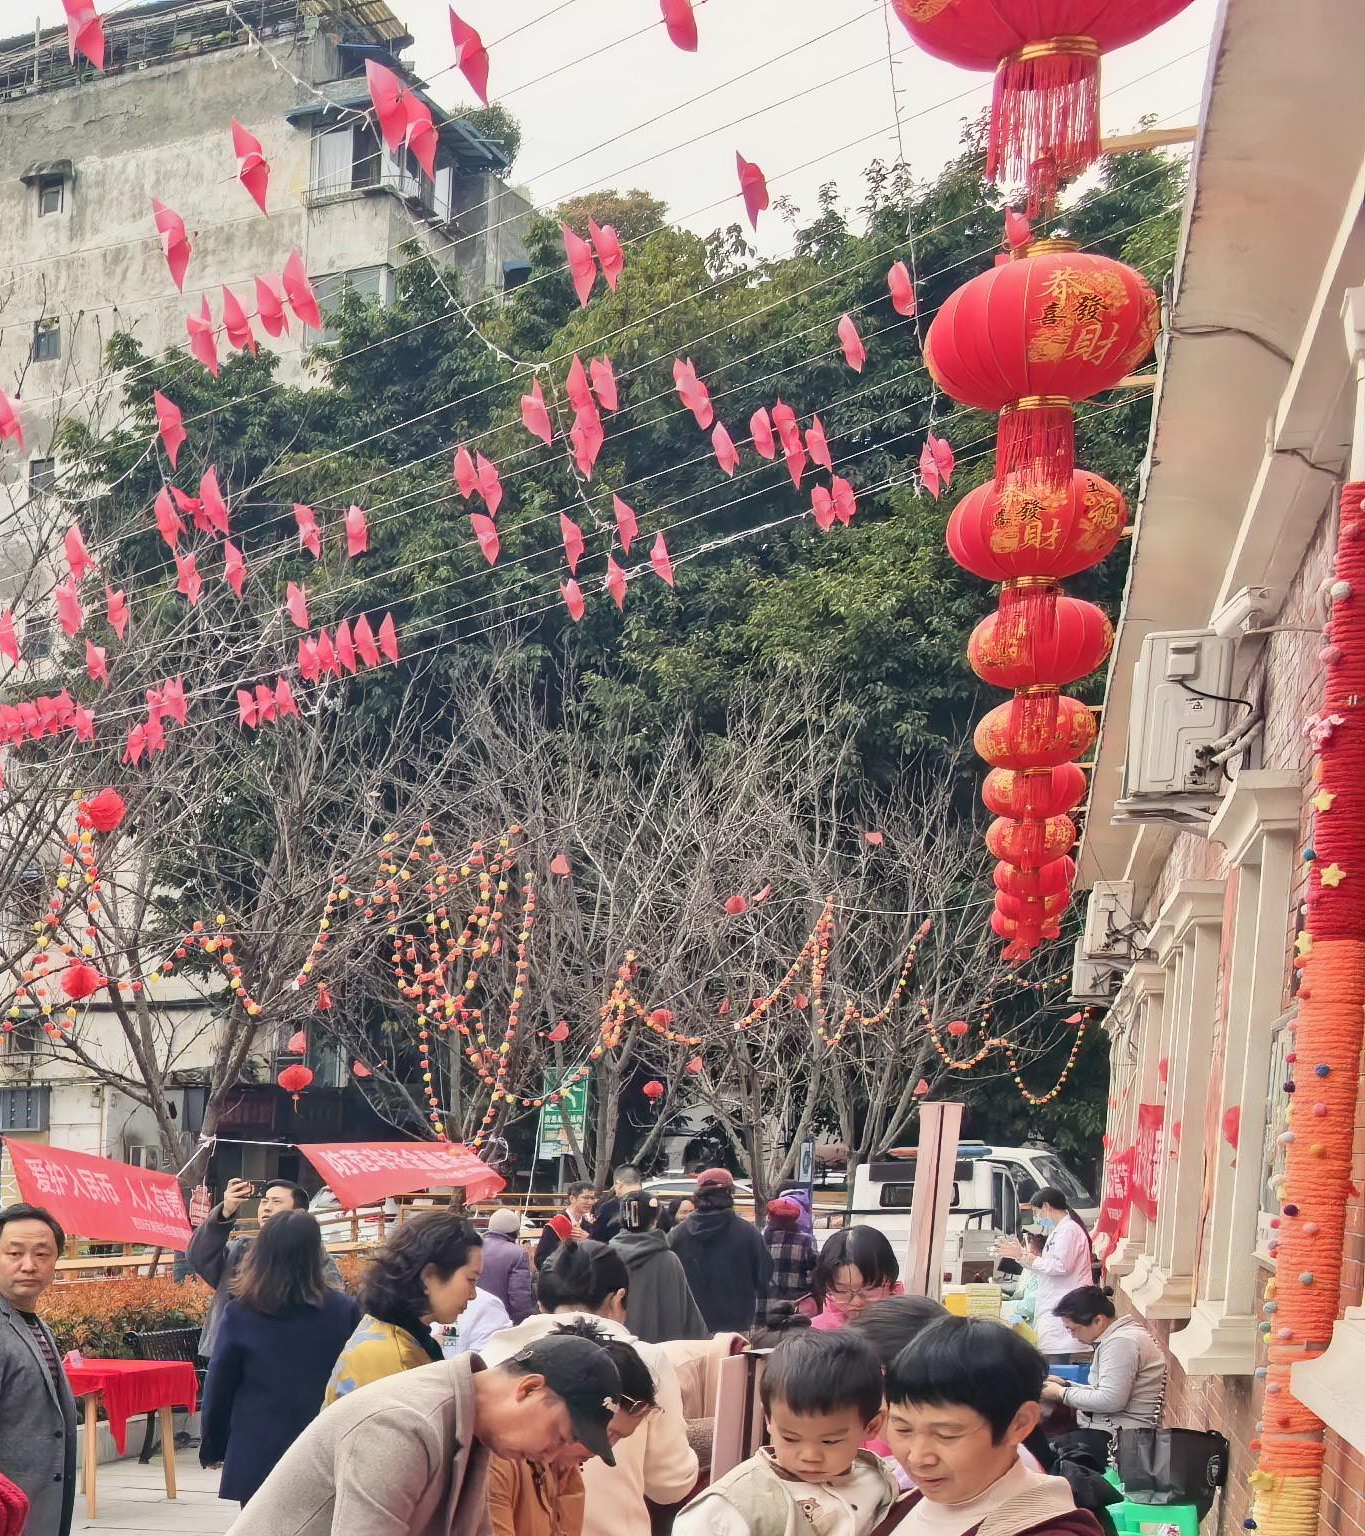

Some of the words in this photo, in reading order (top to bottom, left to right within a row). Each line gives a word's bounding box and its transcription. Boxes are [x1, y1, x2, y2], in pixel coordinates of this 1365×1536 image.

[24, 1159, 121, 1206] 爱护人民币
